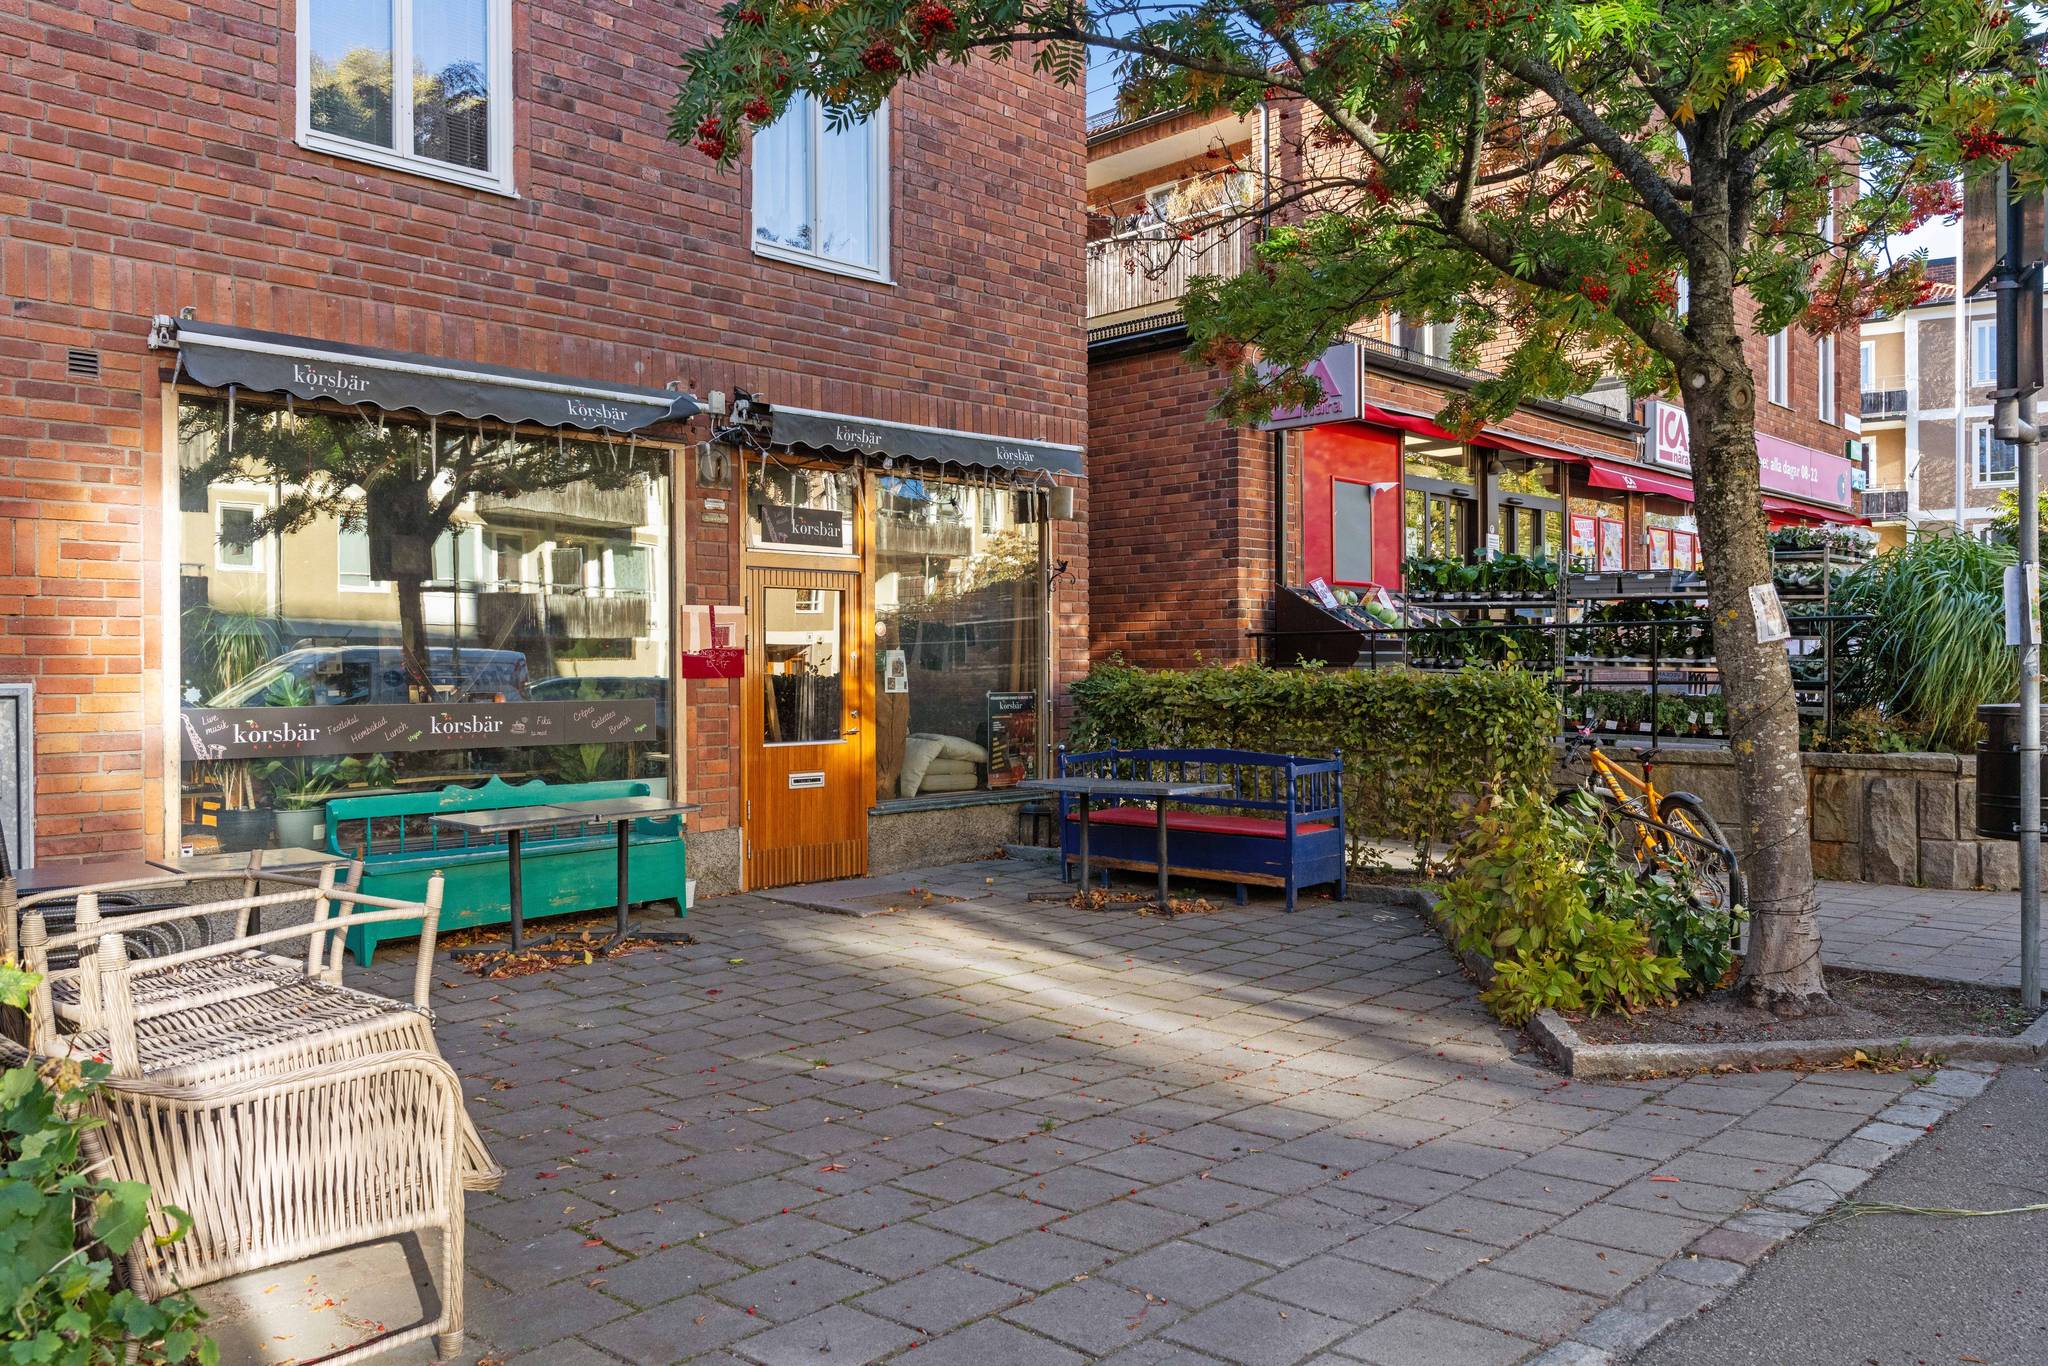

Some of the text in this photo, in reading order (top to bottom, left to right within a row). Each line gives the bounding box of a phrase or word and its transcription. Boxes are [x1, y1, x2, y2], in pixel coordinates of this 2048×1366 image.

[293, 364, 370, 391] körsbär
[567, 399, 628, 421] körsbär
[836, 425, 882, 445] körsbär
[1658, 408, 1689, 452] ICA
[202, 715, 219, 726] Live
[206, 720, 230, 735] musik
[327, 714, 359, 736] Festlokal
[608, 715, 632, 735] Brunch
[384, 721, 409, 742] Lunch
